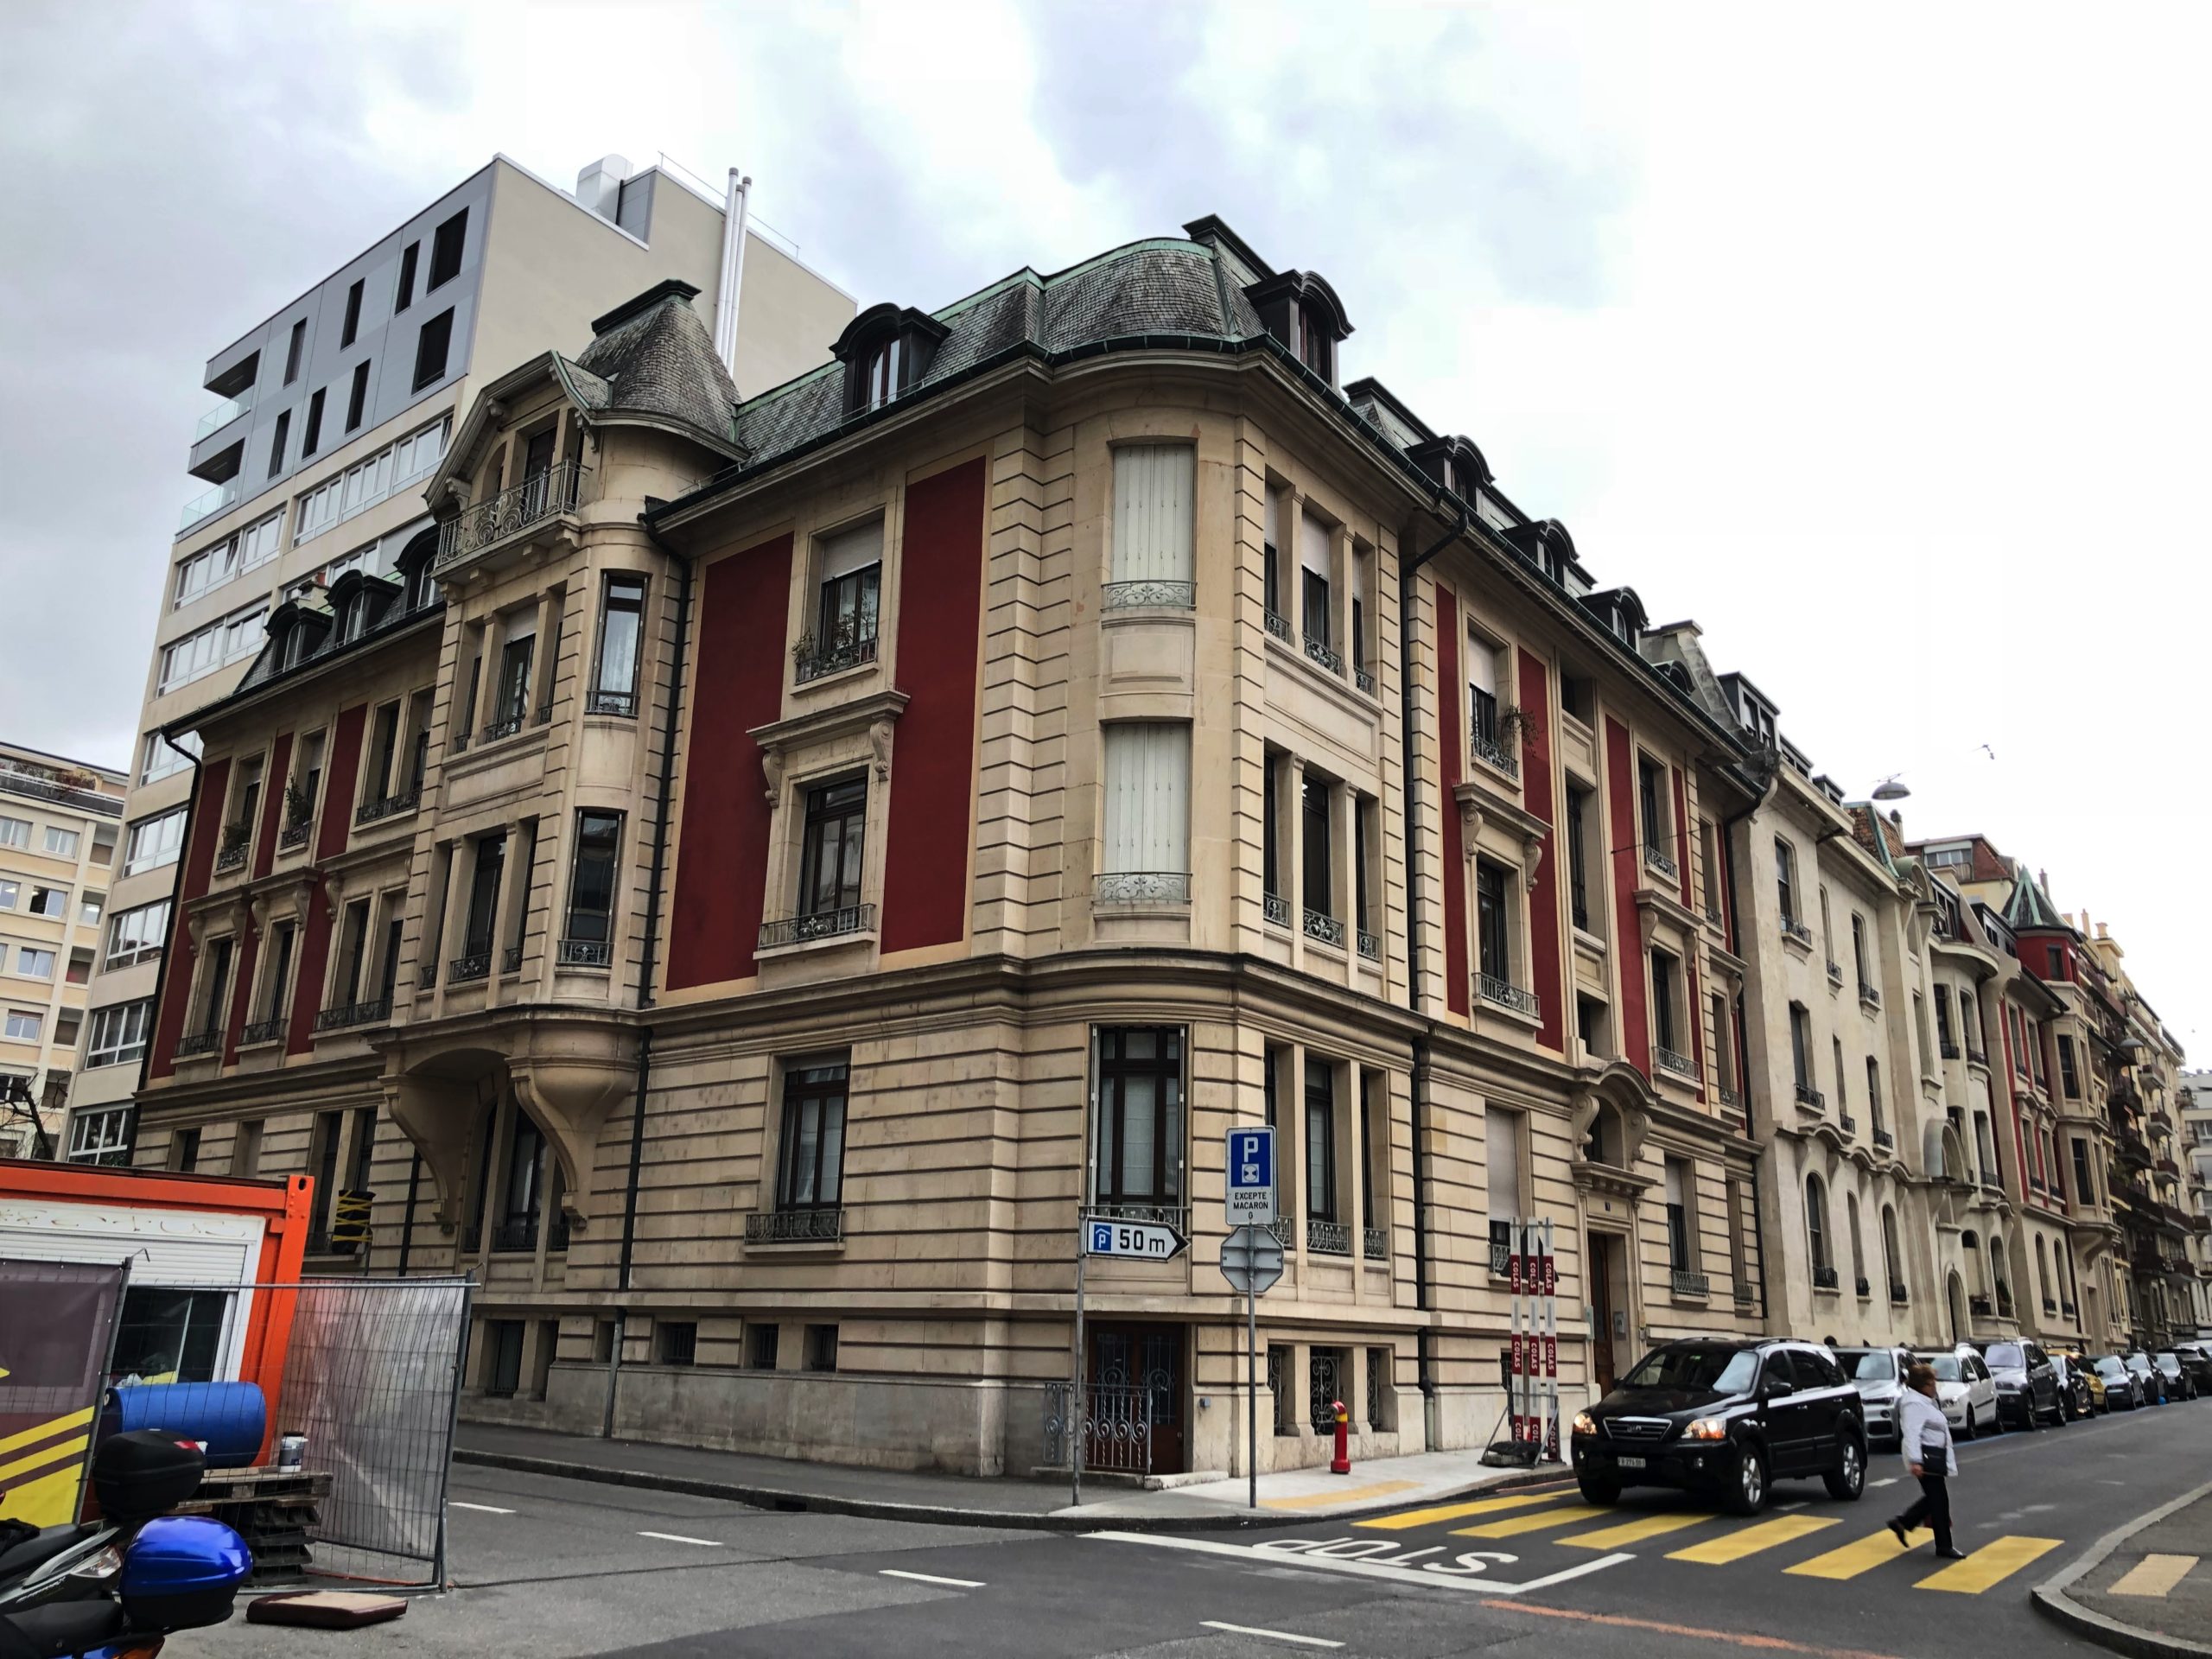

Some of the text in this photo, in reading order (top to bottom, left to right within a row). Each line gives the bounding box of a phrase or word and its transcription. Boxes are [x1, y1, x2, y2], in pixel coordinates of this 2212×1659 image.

[1244, 1137, 1258, 1162] P
[1233, 1201, 1268, 1210] MACARON
[1235, 1192, 1267, 1200] EXCEPTE
[1119, 1229, 1144, 1250] 50
[1149, 1238, 1165, 1253] m
[1253, 1537, 1519, 1573] STOP
